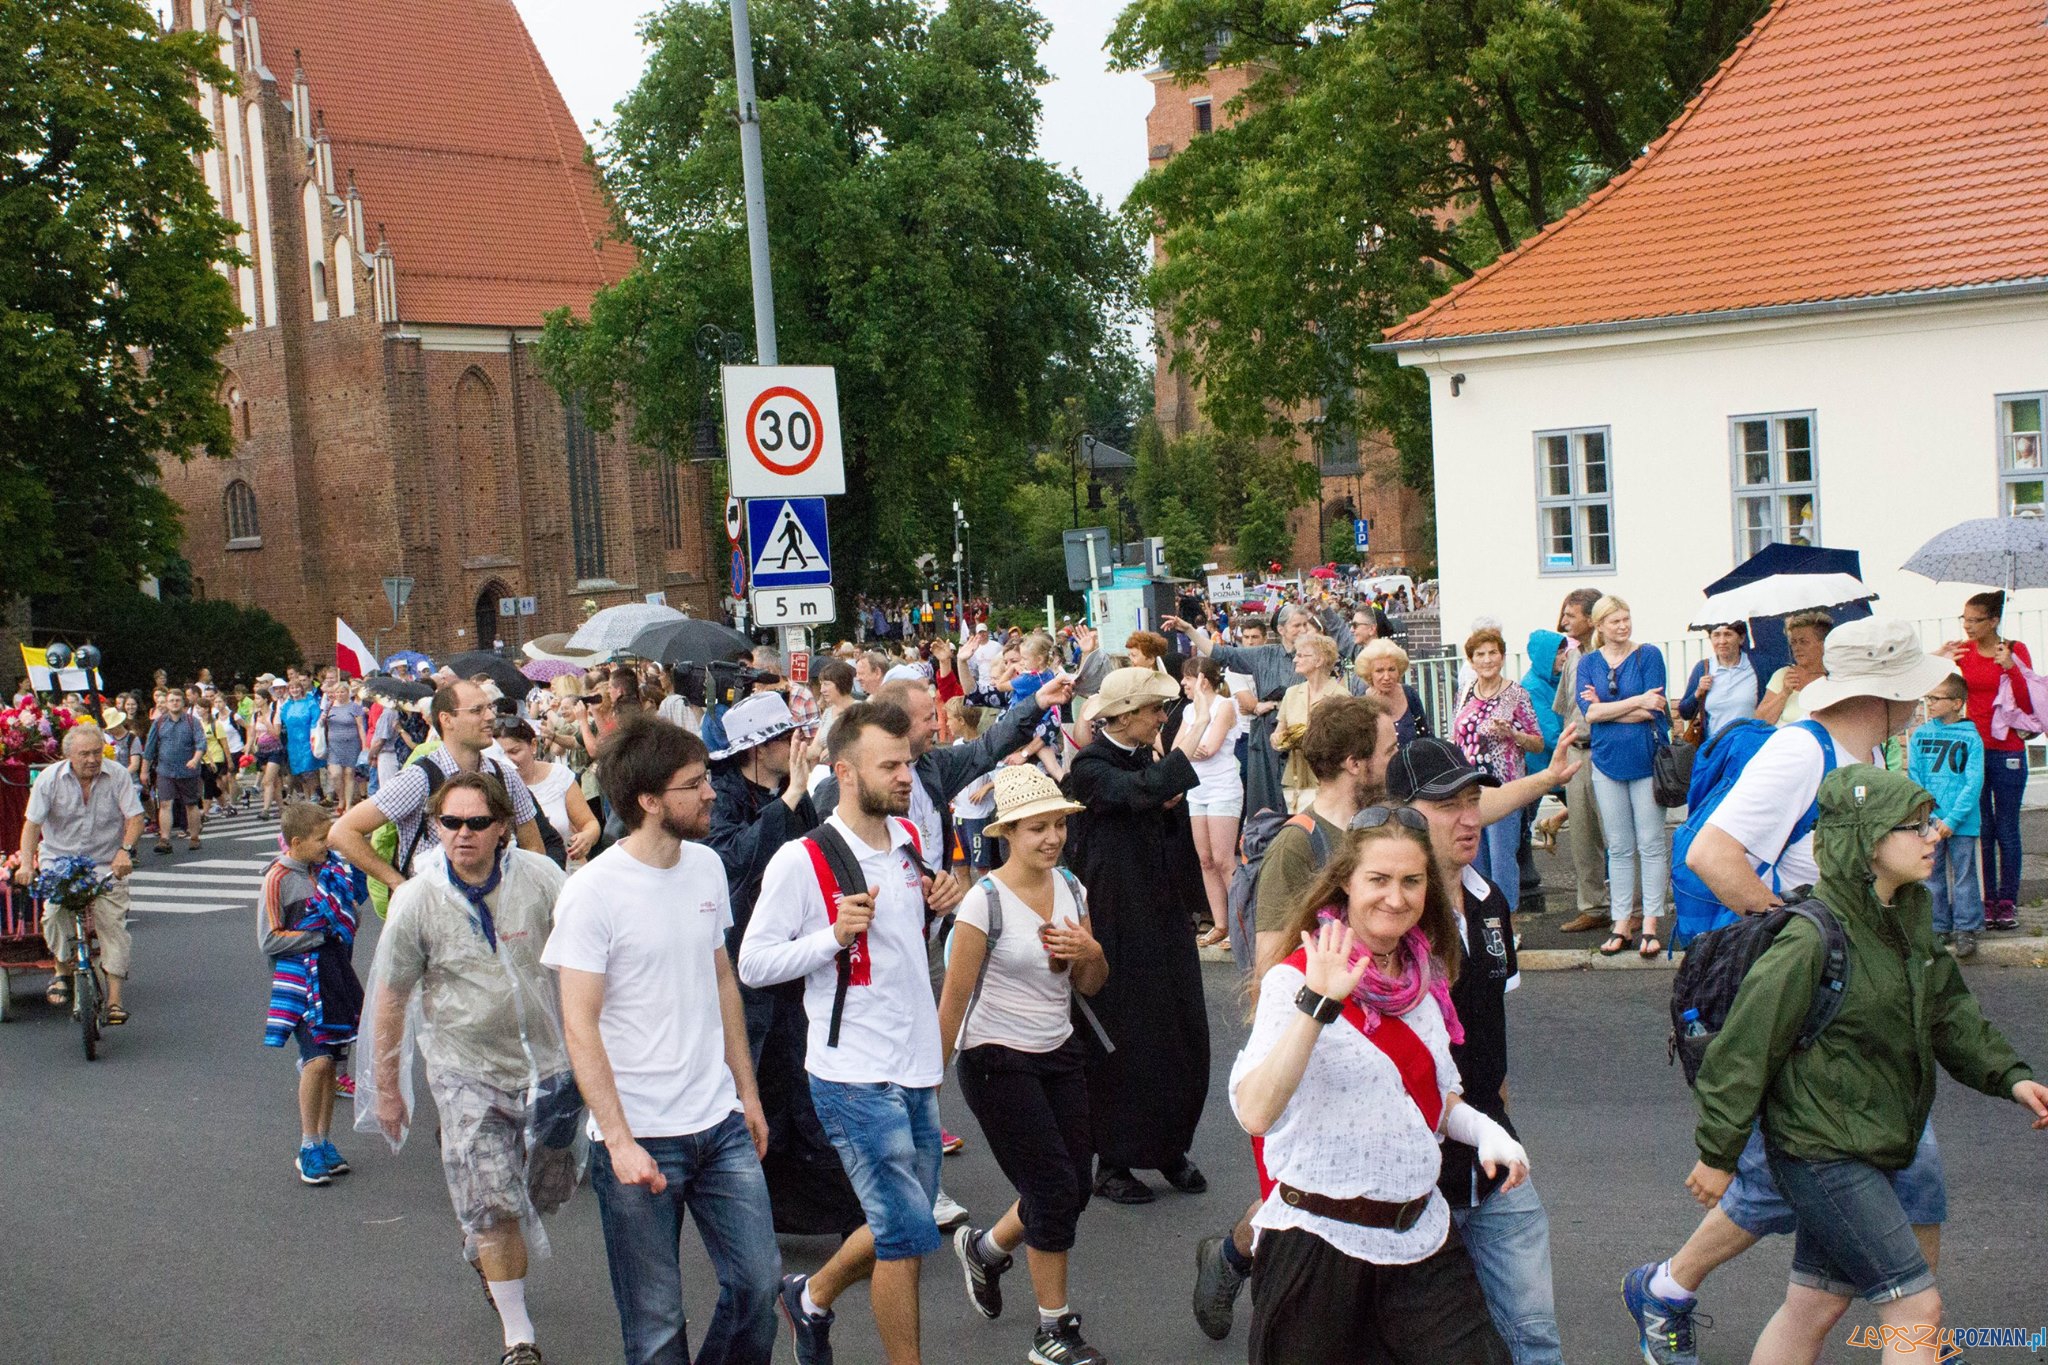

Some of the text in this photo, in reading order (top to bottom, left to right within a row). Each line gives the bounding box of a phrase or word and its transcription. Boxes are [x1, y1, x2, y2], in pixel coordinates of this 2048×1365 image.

[759, 409, 812, 451] 30
[1358, 533, 1367, 544] P
[1220, 581, 1232, 591] 14
[776, 597, 818, 617] 5 m
